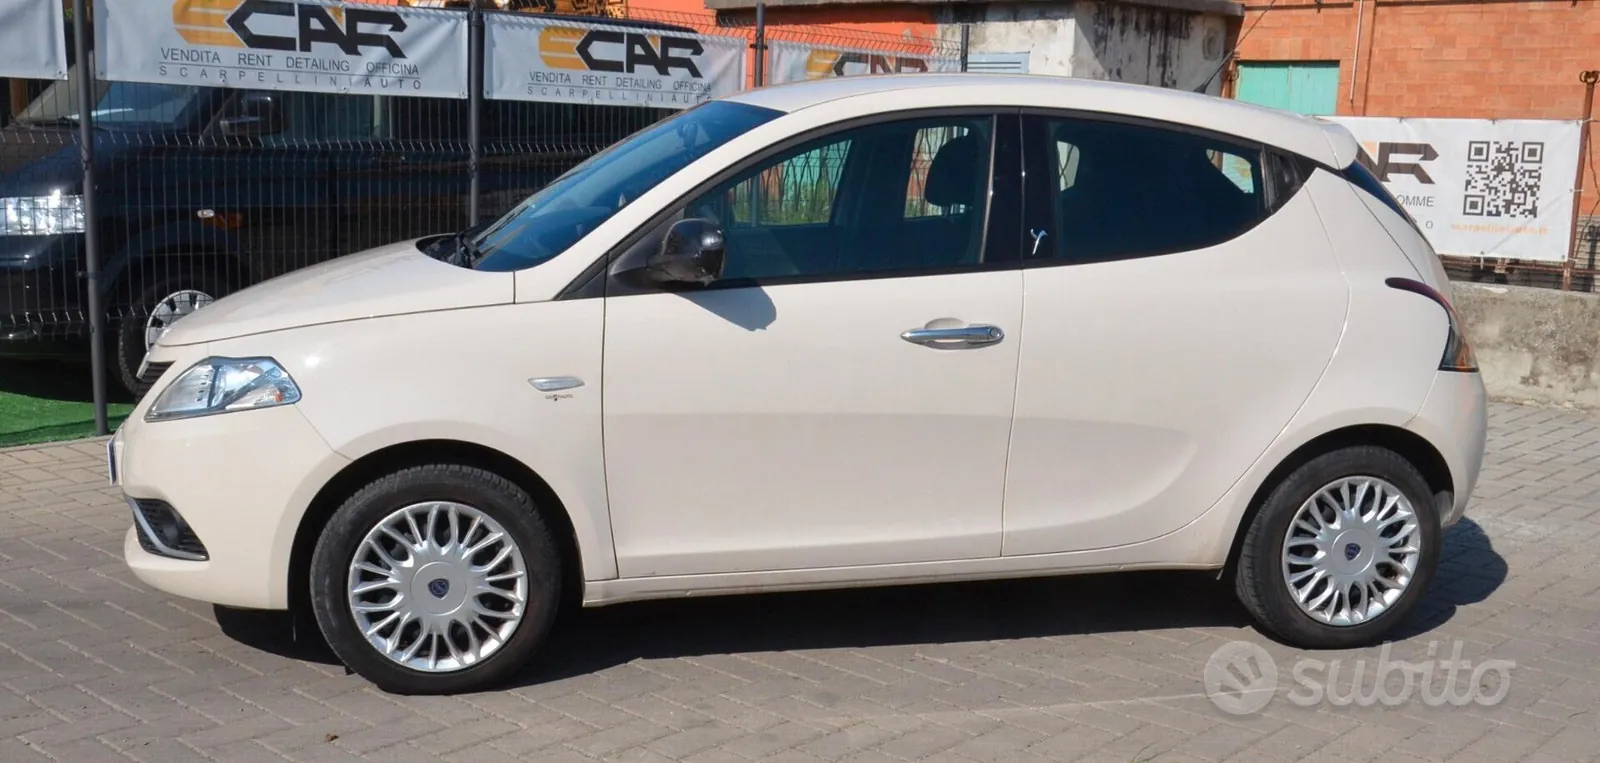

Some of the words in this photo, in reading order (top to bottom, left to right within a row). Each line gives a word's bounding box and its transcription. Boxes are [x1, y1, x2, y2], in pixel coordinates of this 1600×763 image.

[172, 0, 408, 58] SCAR
[160, 47, 221, 63] VENDITA
[238, 53, 272, 66] RENT
[286, 56, 350, 71] DETAILING
[366, 62, 419, 75] OFFICINA
[537, 25, 704, 78] SCAR
[529, 71, 571, 83] VENDITA
[582, 75, 607, 86] RENT
[616, 77, 662, 89] DETAILING
[673, 81, 712, 92] OFFICINA
[1396, 194, 1435, 207] OMME
